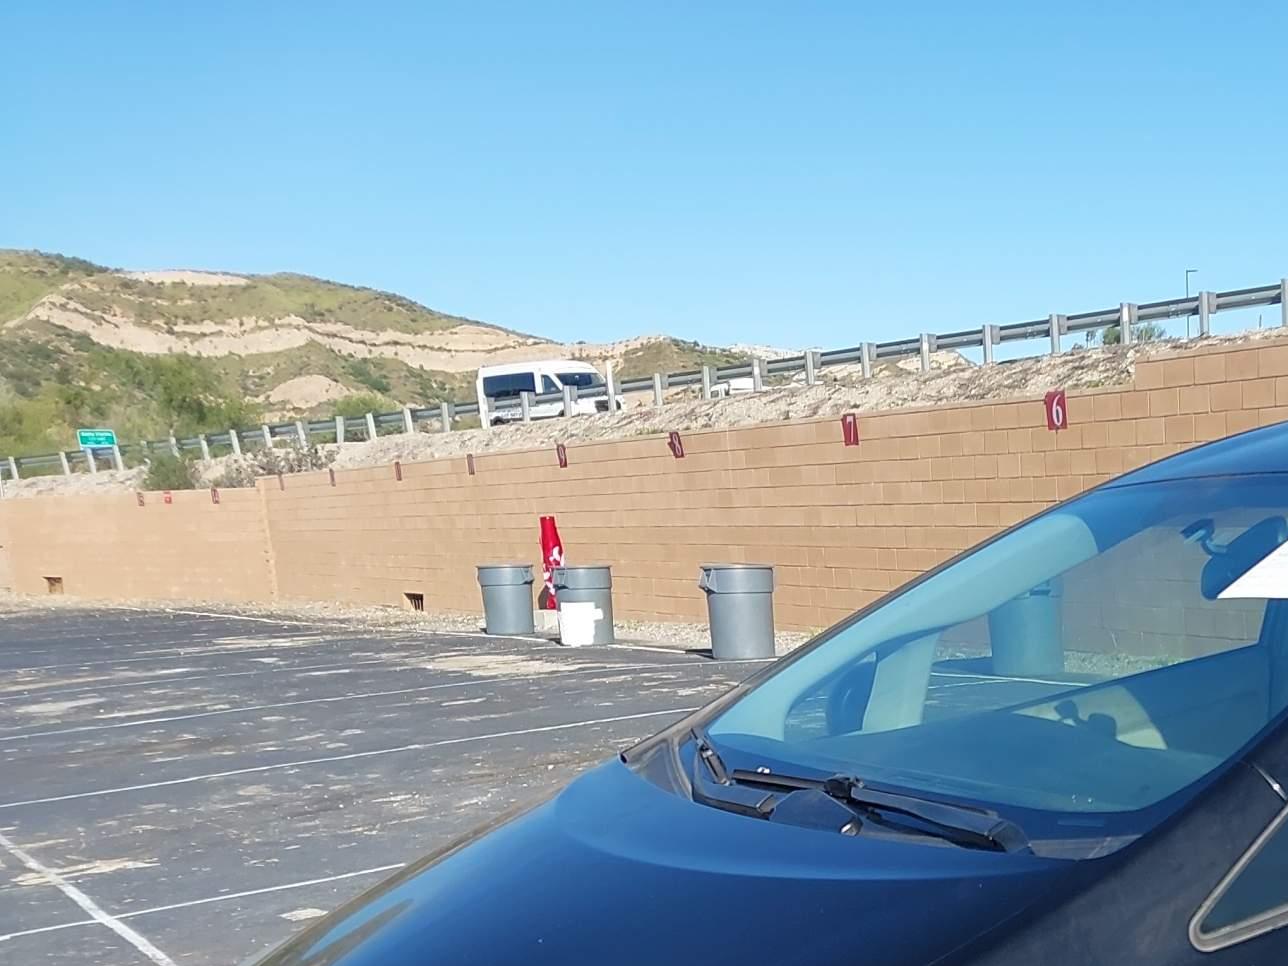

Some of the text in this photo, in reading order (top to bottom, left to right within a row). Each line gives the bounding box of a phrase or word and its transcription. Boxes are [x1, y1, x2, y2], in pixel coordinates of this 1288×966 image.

[1051, 394, 1063, 426] 6
[846, 415, 854, 443] 7
[671, 432, 683, 456] 8
